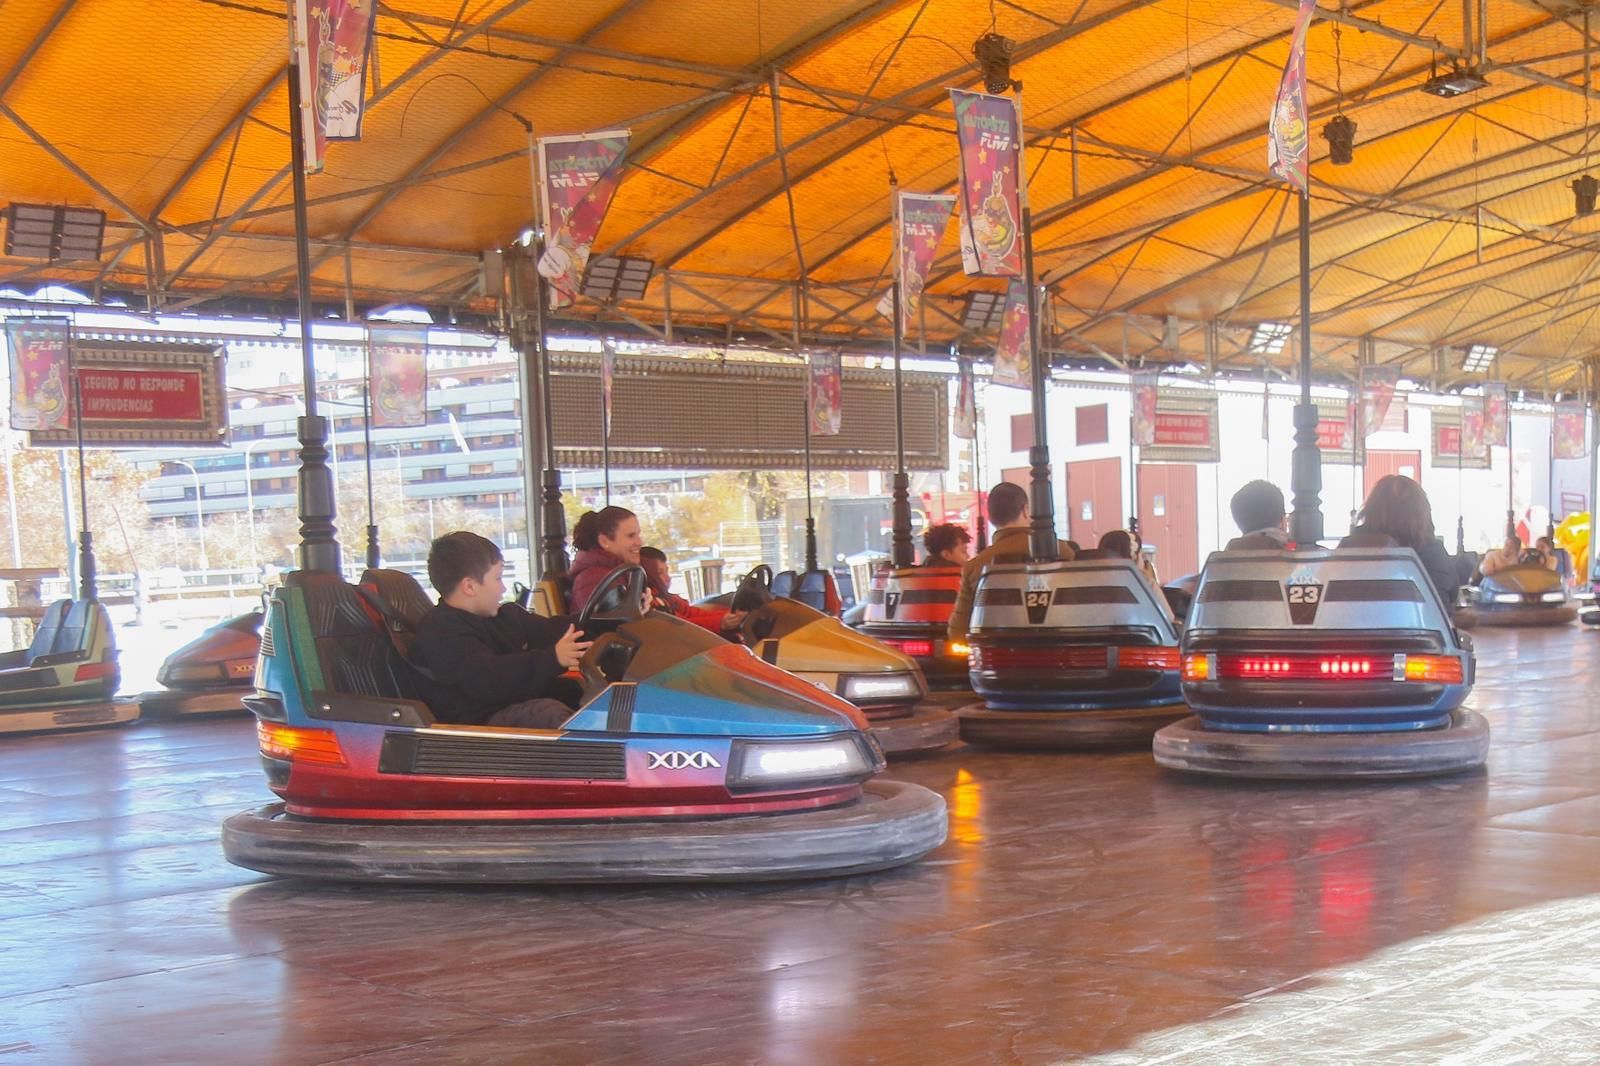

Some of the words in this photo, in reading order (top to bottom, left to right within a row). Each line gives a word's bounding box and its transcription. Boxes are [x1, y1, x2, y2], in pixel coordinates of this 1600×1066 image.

[980, 132, 1010, 151] FLM
[28, 341, 64, 351] FLM
[84, 376, 119, 389] SEGURO
[123, 378, 136, 390] NO
[140, 379, 185, 392] RESPONDE
[88, 398, 153, 412] IMPRUDENCIAS
[889, 593, 897, 606] 7
[1027, 593, 1049, 607] 24
[1289, 586, 1319, 604] 23
